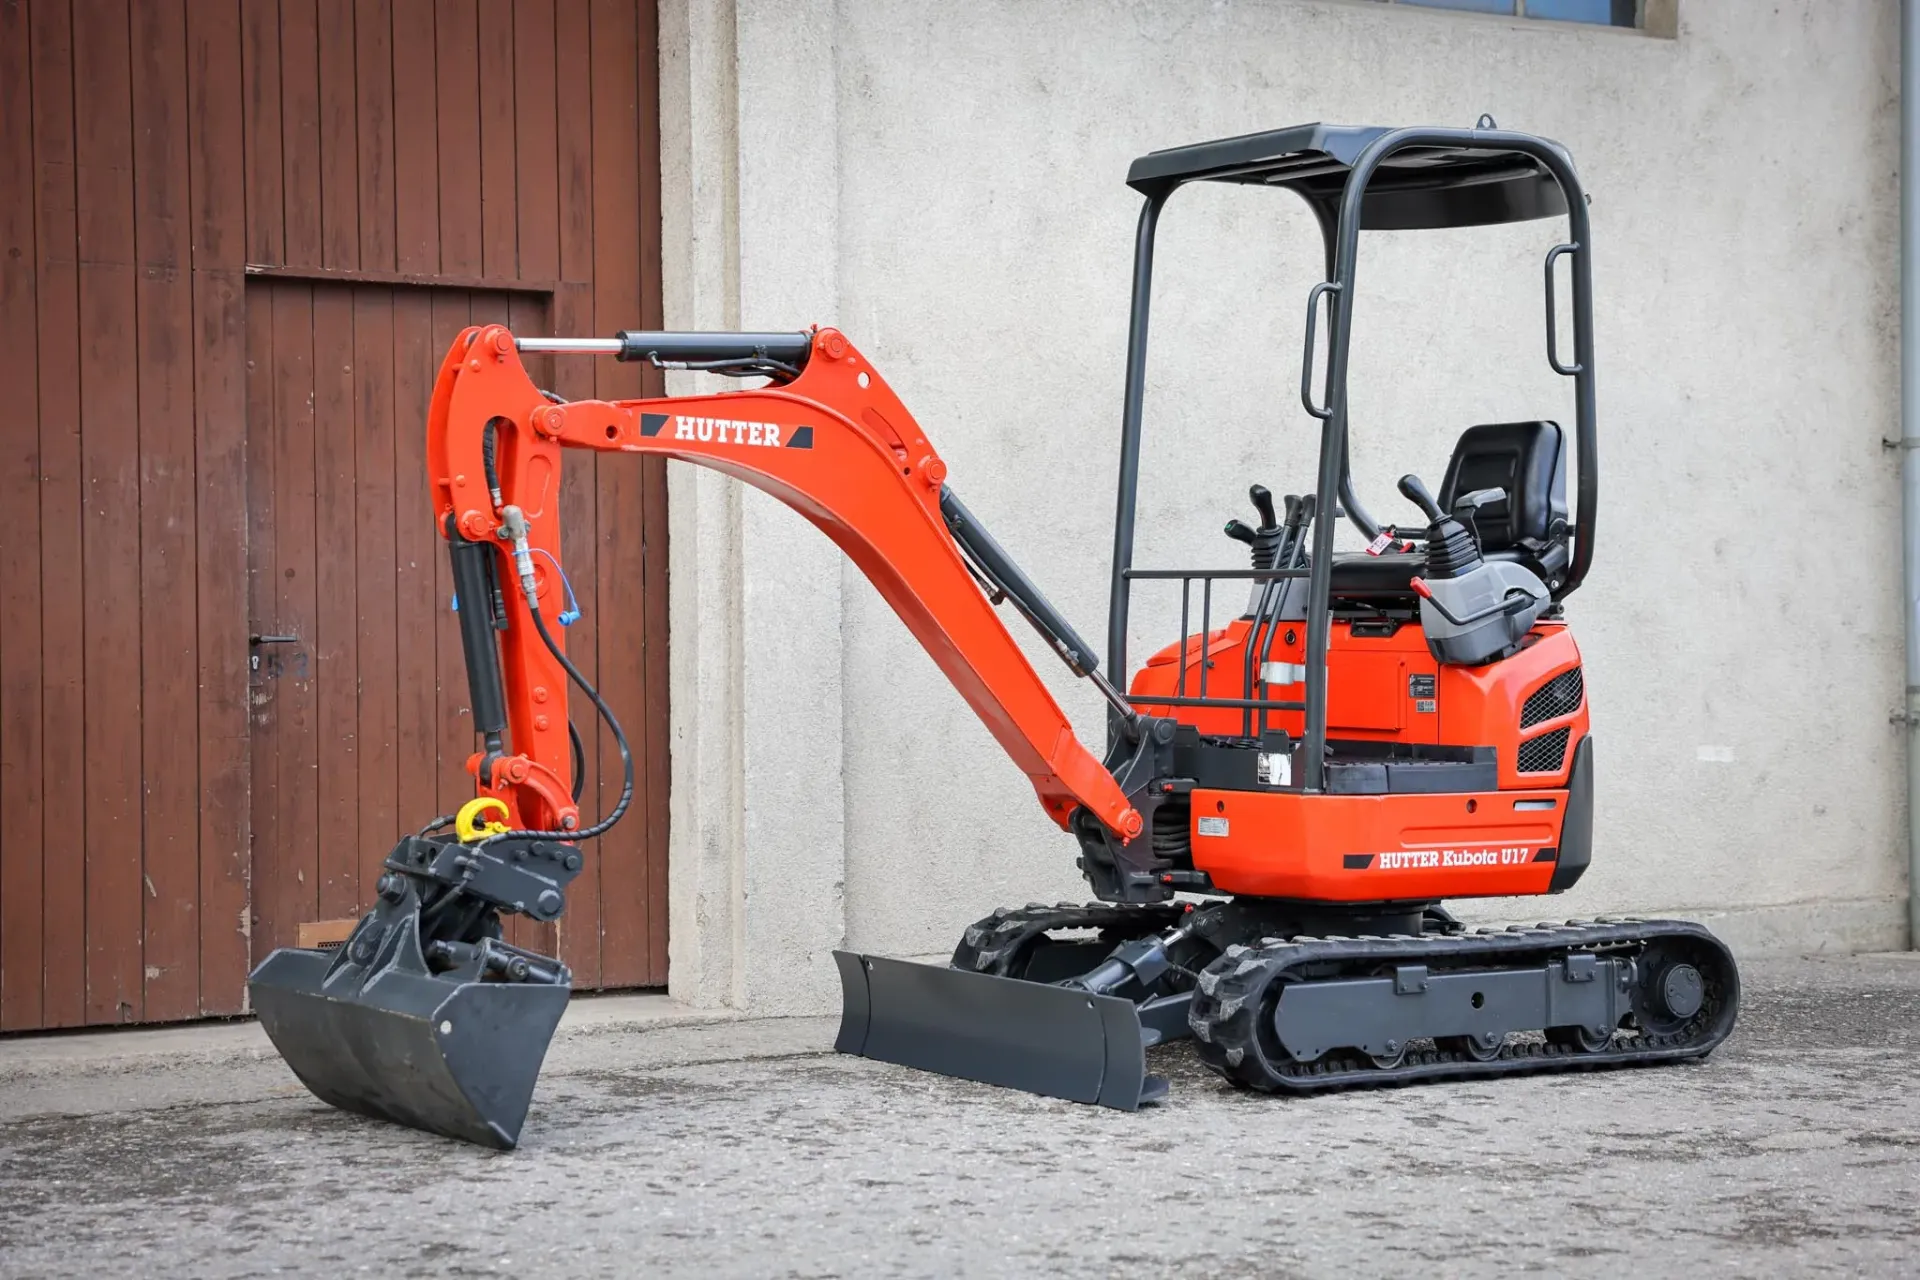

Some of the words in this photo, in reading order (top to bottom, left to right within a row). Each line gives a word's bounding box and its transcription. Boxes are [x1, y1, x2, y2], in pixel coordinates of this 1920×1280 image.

[674, 416, 781, 447] HUTTER
[1379, 851, 1439, 869] HUTTER
[1442, 849, 1497, 867] Kubota
[1502, 848, 1529, 864] U17
